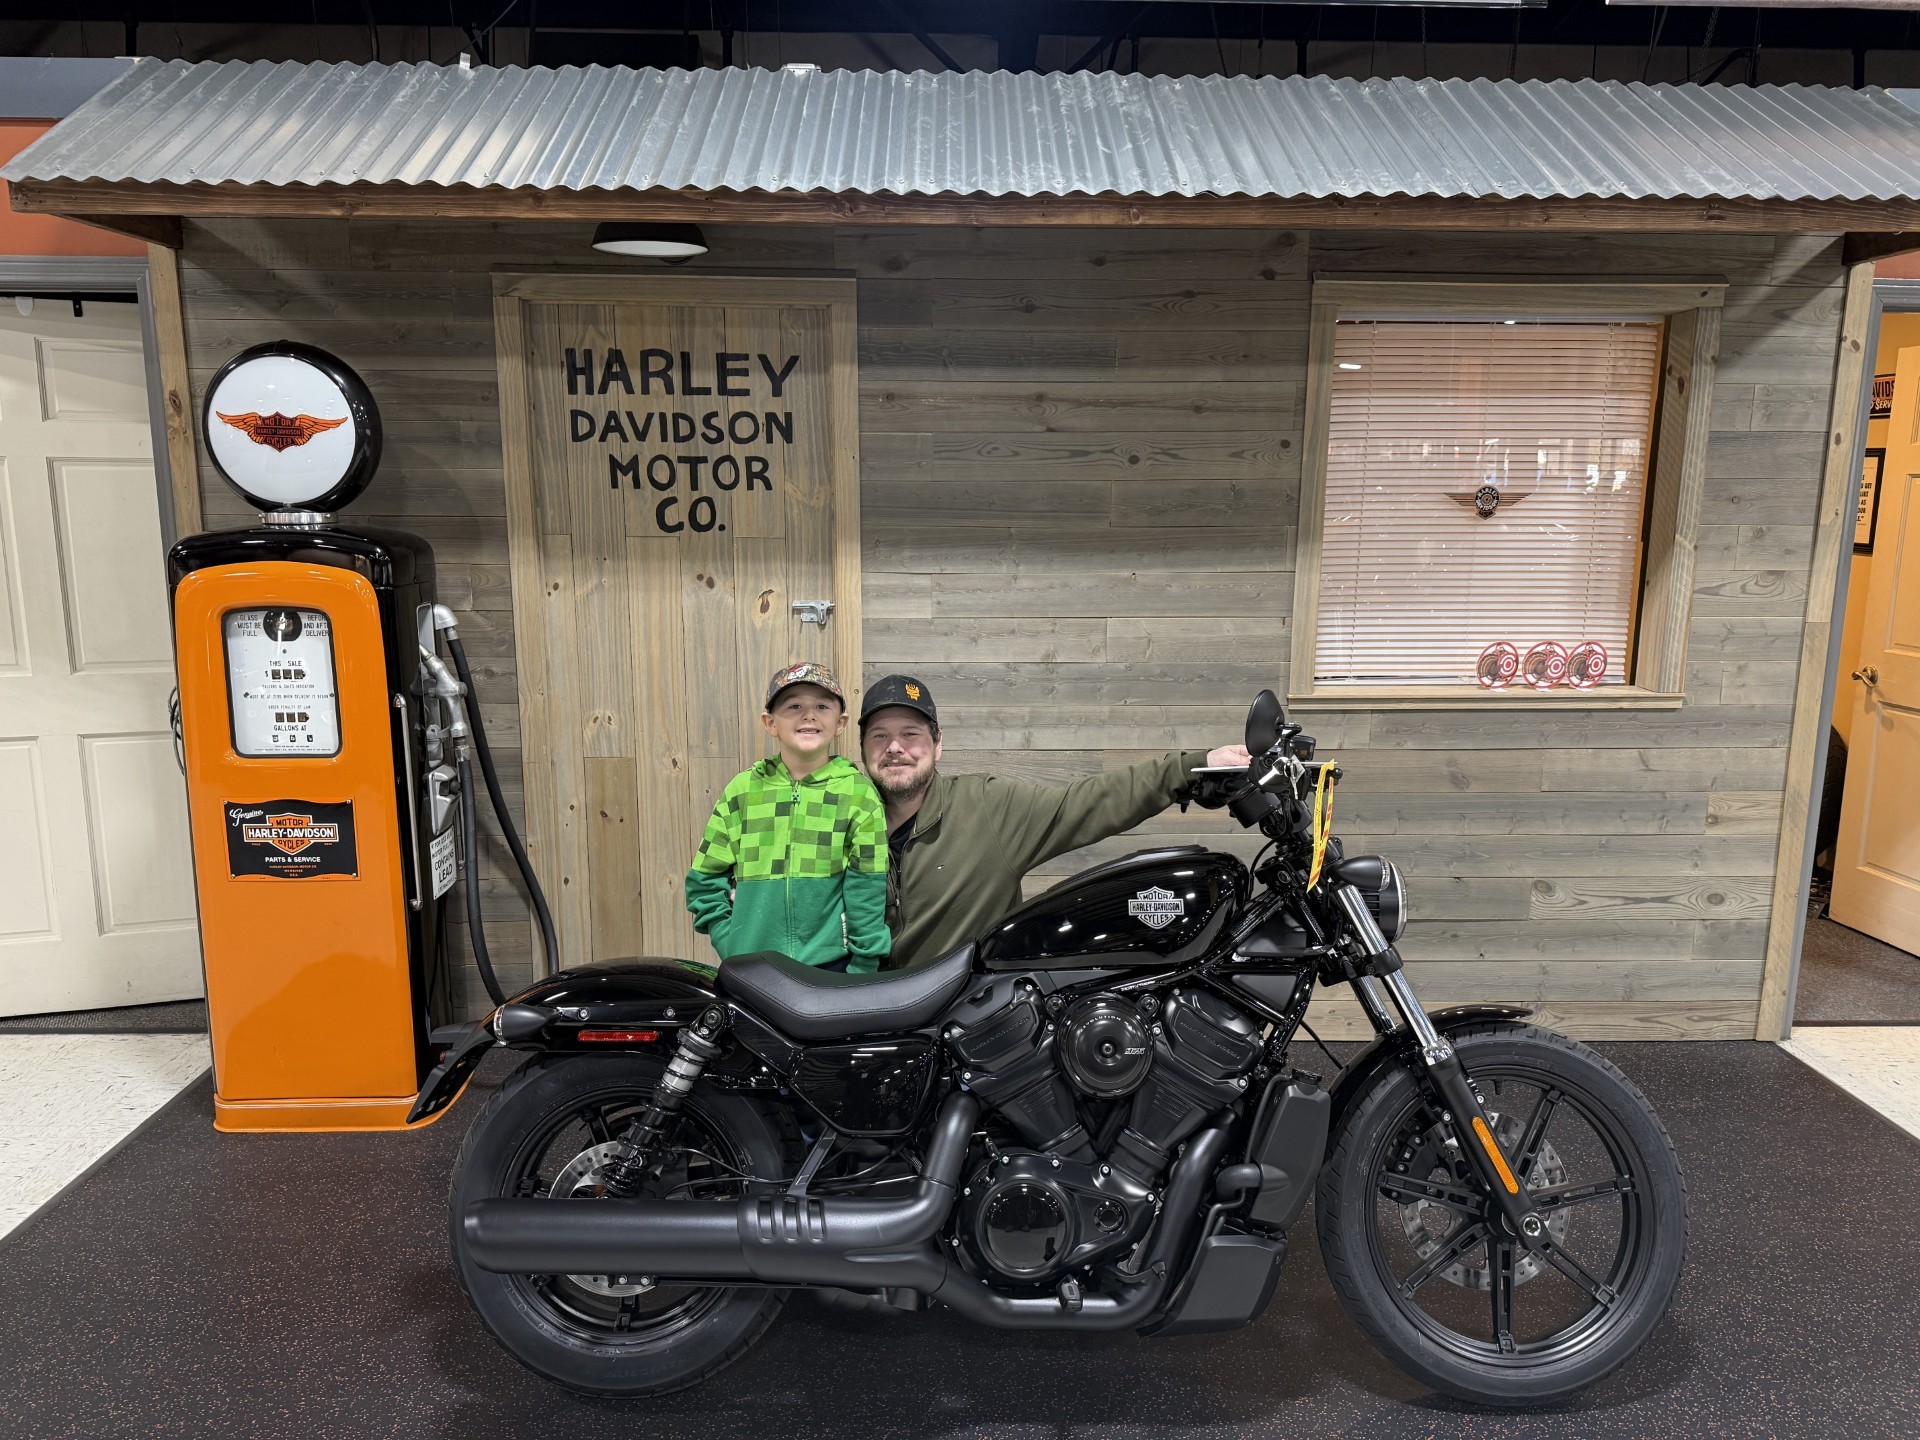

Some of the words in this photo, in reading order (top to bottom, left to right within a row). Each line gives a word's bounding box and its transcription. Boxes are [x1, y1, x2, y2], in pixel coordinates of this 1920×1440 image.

[564, 347, 800, 398] HARLEY
[1872, 380, 1895, 398] AVIDS
[264, 415, 292, 426] MOTOR
[569, 408, 793, 445] DAVIDSON
[266, 436, 292, 448] CYCLES
[608, 453, 773, 492] MOTOR
[1476, 488, 1498, 498] HARLEY
[1476, 499, 1498, 511] DAVIDSON
[655, 495, 726, 534] CO.
[229, 808, 264, 827] Genuine
[276, 818, 304, 826] MOTOR
[248, 828, 334, 838] HARLEY-DAVIDSON
[278, 839, 305, 850] CYCLES
[435, 848, 454, 870] CONTAINS
[439, 864, 453, 883] LEAD
[1142, 891, 1168, 900] MOTOR
[1132, 902, 1180, 912] HARLEY-DAVIDSON
[1144, 914, 1170, 924] CYCLES
